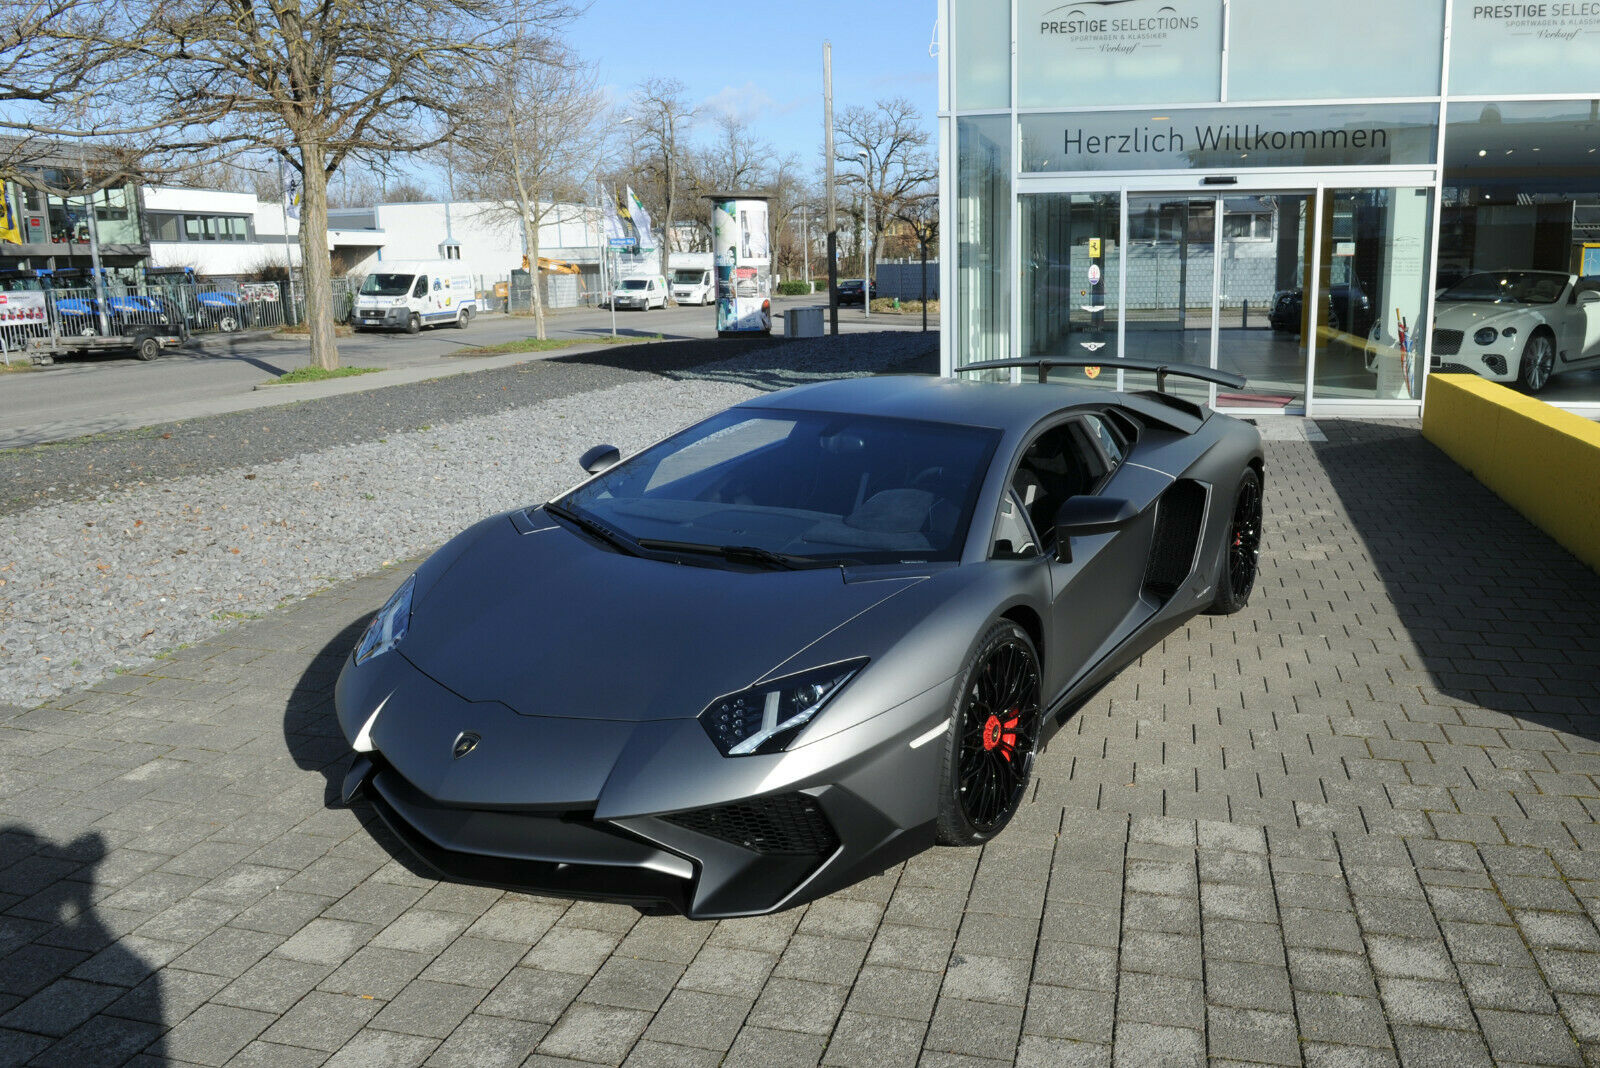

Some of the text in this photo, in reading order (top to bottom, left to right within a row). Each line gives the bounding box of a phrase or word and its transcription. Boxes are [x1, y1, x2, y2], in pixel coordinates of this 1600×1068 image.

[1473, 2, 1600, 19] PRESTIGE SELEC
[1041, 16, 1199, 34] PRESTIGE SELECTIONS
[1070, 34, 1118, 42] SPORTWAGEN
[1128, 32, 1167, 40] KLASSIKER
[1064, 124, 1387, 155] Herzlich Willkommen
